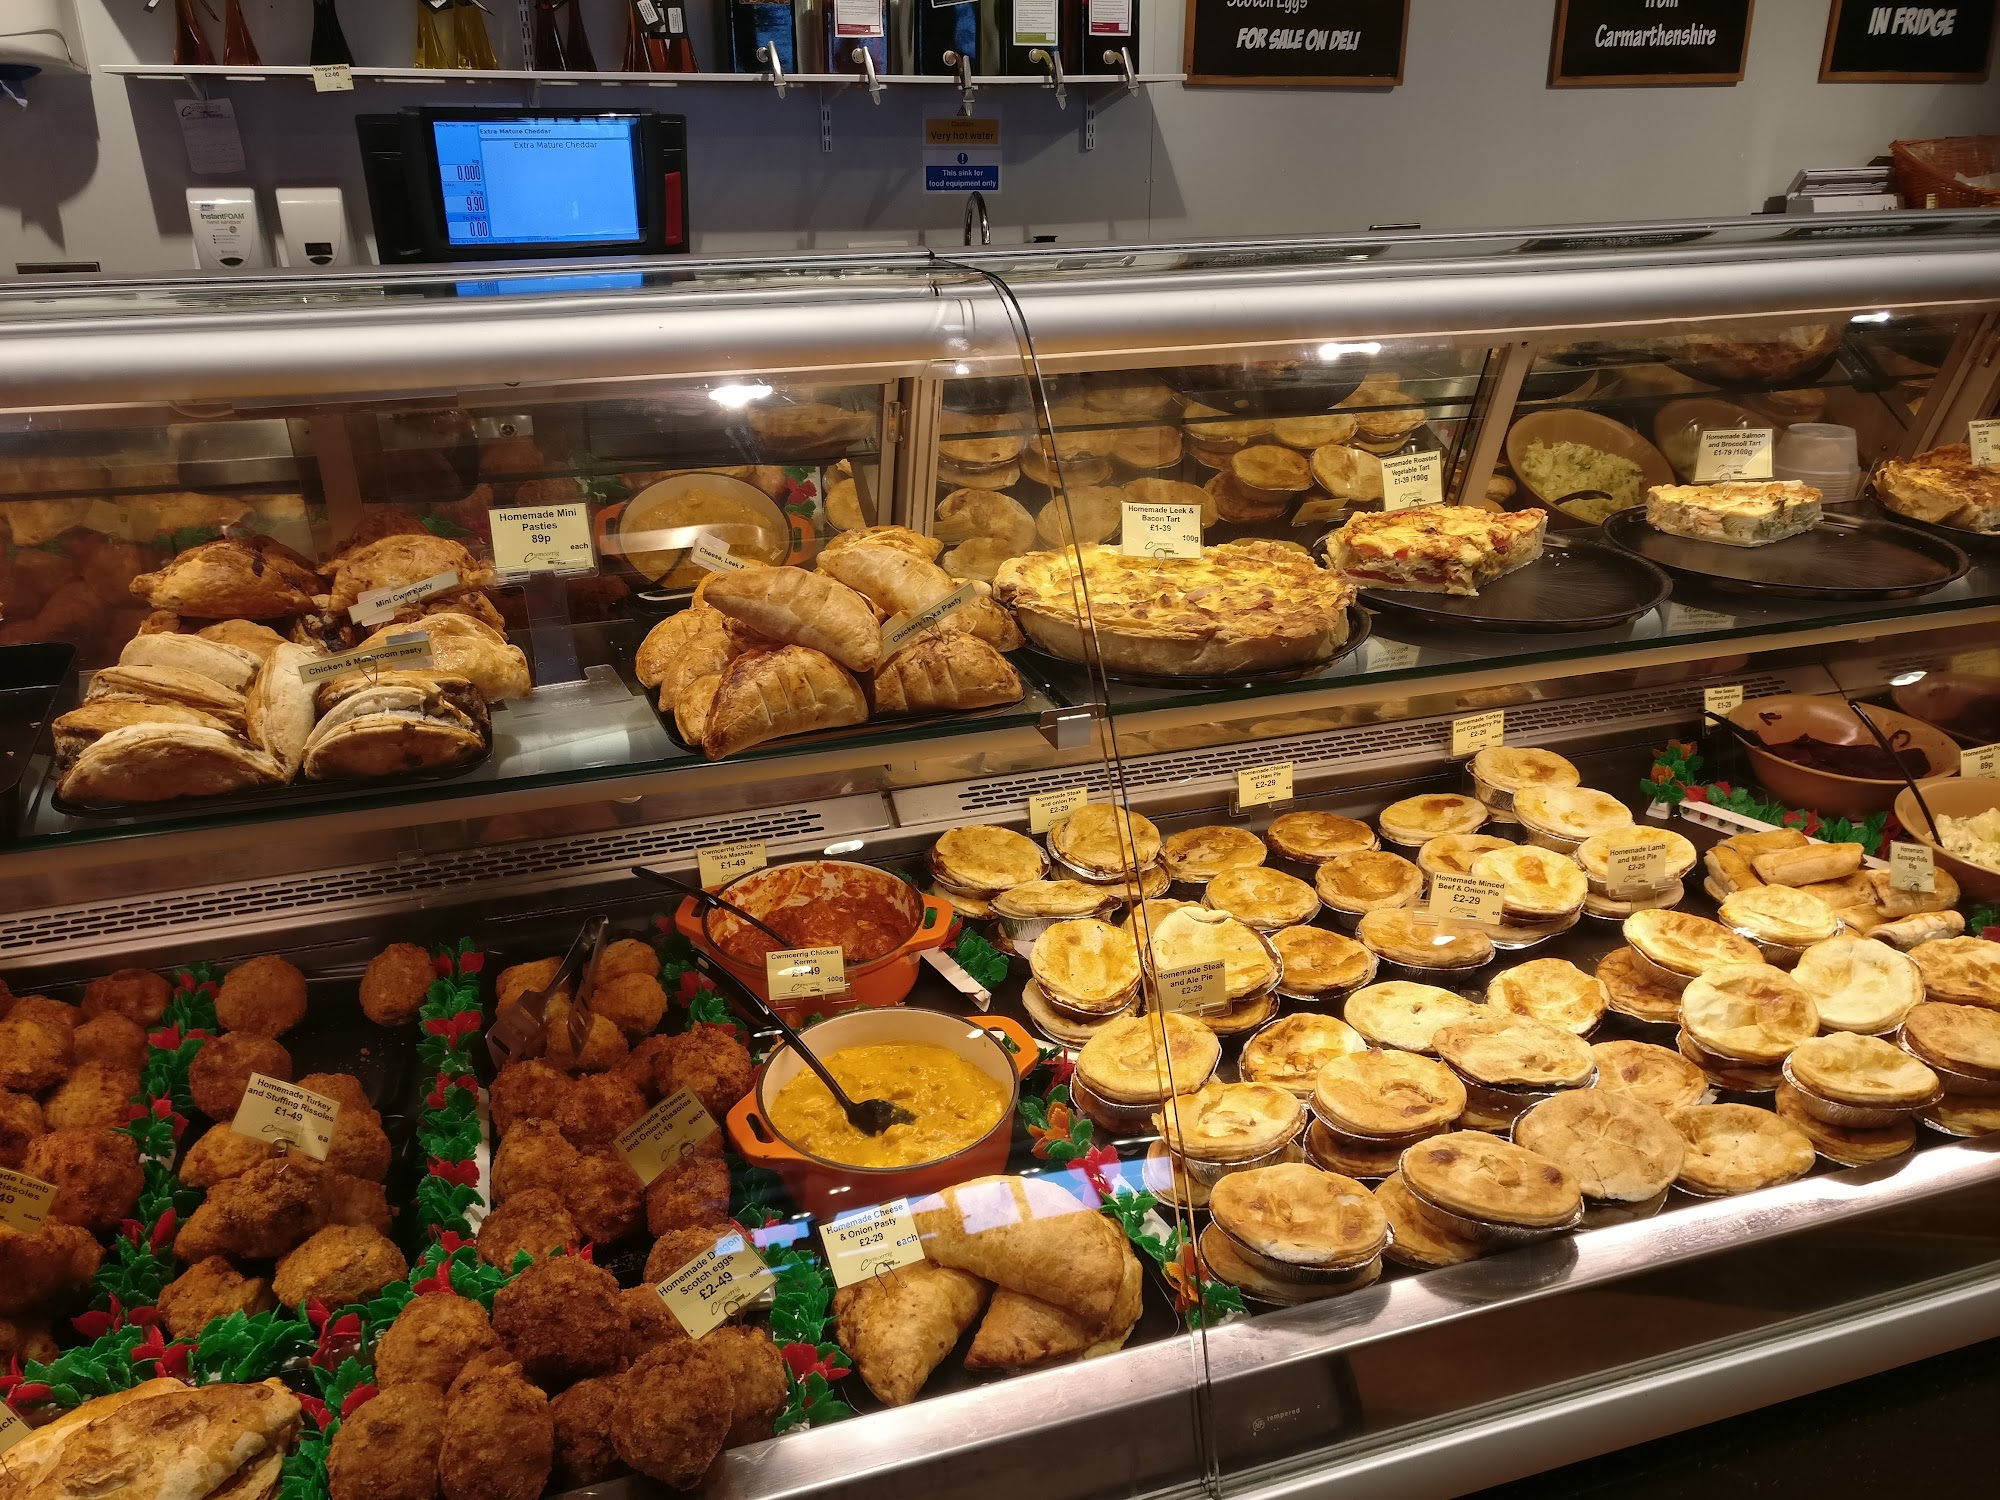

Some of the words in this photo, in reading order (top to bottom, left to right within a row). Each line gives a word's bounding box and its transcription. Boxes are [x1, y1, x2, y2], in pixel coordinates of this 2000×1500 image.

[1867, 7, 1892, 36] IN
[1891, 7, 1957, 37] FRIDGE
[1236, 27, 1268, 49] FOR
[1269, 29, 1305, 49] SALE
[1305, 29, 1329, 51] ON
[1329, 30, 1361, 51] DELI
[1595, 23, 1717, 47] Carmarthenshire
[931, 131, 950, 142] Very
[954, 132, 968, 140] hot
[971, 132, 994, 140] water
[514, 141, 535, 149] Extra
[537, 141, 564, 149] Mature
[566, 141, 598, 149] Cheddar
[946, 180, 981, 188] equipment
[982, 180, 997, 188] only
[1706, 433, 1740, 441] Homemade
[1384, 459, 1412, 469] Homemade
[1413, 455, 1437, 464] Roasted
[1392, 467, 1418, 476] Vegetable
[1419, 464, 1431, 472] Tart
[499, 510, 554, 522] Homemade
[557, 508, 577, 518] Mini
[1128, 505, 1168, 514] Homemade
[1142, 514, 1165, 522] Bacon
[522, 522, 558, 532] Pasties
[1150, 524, 1172, 532] £1-39
[532, 534, 551, 544] 89p
[570, 542, 589, 550] each
[375, 597, 391, 608] Mini
[892, 621, 920, 643] Chicken
[941, 597, 962, 612] Pasty
[309, 663, 343, 675] Chicken
[400, 647, 422, 656] pasty
[1455, 717, 1484, 726] Homemade
[736, 843, 761, 851] Chicken
[1610, 847, 1647, 856] Homemade
[721, 858, 746, 869] £1-49
[1628, 863, 1646, 871] £2-29
[1435, 874, 1477, 886] Homemade
[1478, 880, 1505, 889] Minced
[1438, 882, 1455, 890] Beef
[1463, 886, 1486, 895] Onion
[1487, 889, 1500, 897] Pie
[1453, 893, 1481, 905] £2-29
[771, 952, 809, 960] Cwmcerrig
[1158, 967, 1201, 980] Homemade
[1203, 961, 1225, 972] Steak
[827, 975, 844, 983] 100g
[1170, 979, 1185, 988] and
[1201, 973, 1213, 982] Pie
[1181, 985, 1203, 995] £2-29
[257, 1078, 304, 1100] Homemade
[306, 1095, 332, 1112] Turkey
[247, 1087, 265, 1097] and
[265, 1091, 299, 1110] Stuffing
[300, 1103, 334, 1122] Rissoles
[274, 1106, 303, 1122] £1-49
[619, 1112, 660, 1145] Homemade
[659, 1092, 687, 1113] Cheese
[688, 1109, 706, 1125] each
[625, 1140, 640, 1153] and
[639, 1121, 662, 1141] Onion
[660, 1098, 692, 1123] Rissoles
[653, 1123, 674, 1141] £1-19
[317, 1134, 329, 1143] ea
[20, 1178, 49, 1193] Lamb
[23, 1213, 42, 1222] each
[826, 1214, 872, 1235] Homemade
[873, 1204, 904, 1219] Cheese
[839, 1233, 847, 1241] &
[848, 1225, 873, 1238] Onion
[874, 1217, 897, 1230] Pasty
[859, 1232, 884, 1247] £2-29
[896, 1233, 918, 1247] each
[658, 1258, 708, 1297] Homemade
[706, 1235, 741, 1260] Dragon
[749, 1264, 766, 1279] each
[680, 1270, 712, 1295] Scotch
[712, 1254, 735, 1273] eggs
[699, 1271, 734, 1301] £2-49
[1266, 1407, 1301, 1422] tempered
